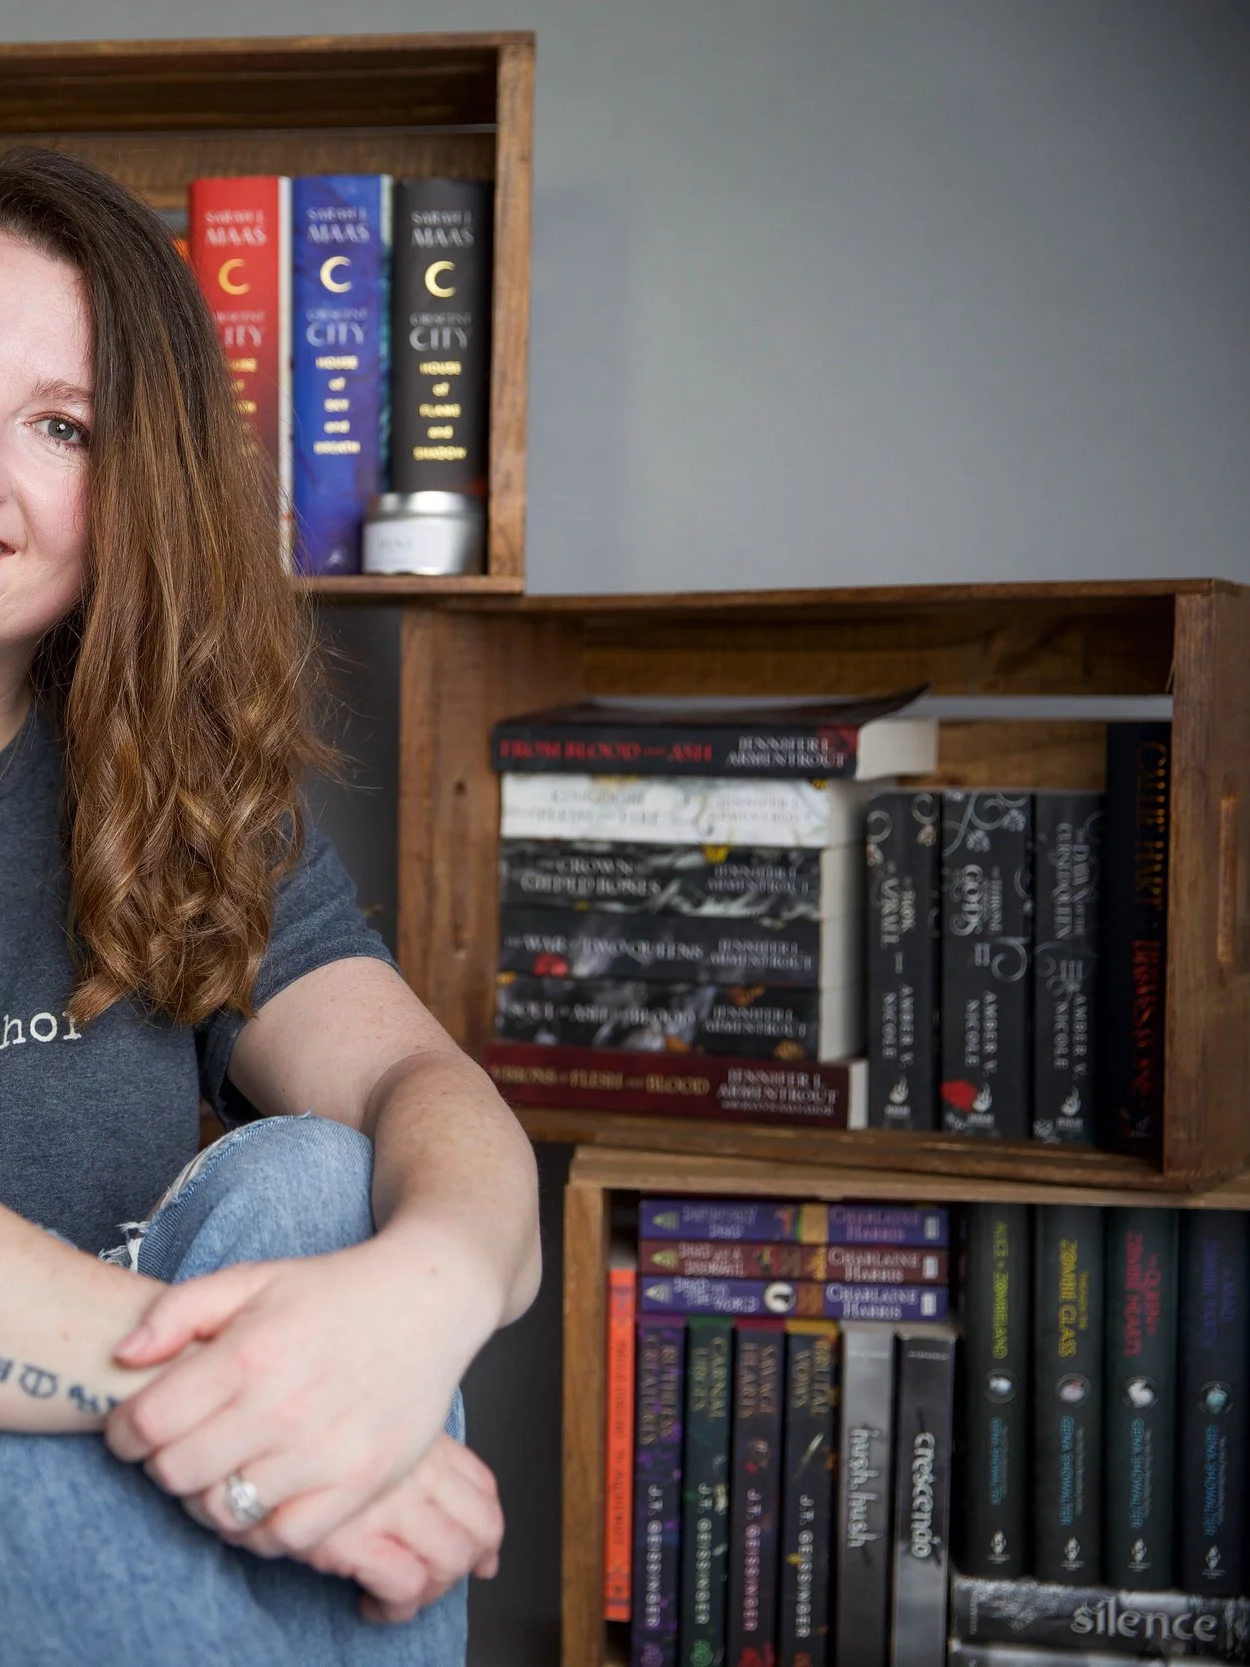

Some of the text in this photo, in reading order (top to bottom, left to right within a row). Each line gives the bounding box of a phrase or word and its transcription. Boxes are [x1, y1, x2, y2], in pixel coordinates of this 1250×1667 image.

[222, 323, 263, 348] ITY
[306, 322, 365, 348] CITY
[409, 325, 469, 351] CITY
[1058, 1304, 1078, 1358] GLASS
[847, 1491, 884, 1548] hush
[910, 1431, 942, 1559] crescendo
[645, 1519, 663, 1628] GEISSINGER
[694, 1517, 713, 1626] GEISSINGER
[742, 1523, 761, 1632] GEISSINGER
[794, 1530, 814, 1639] GEISSINGER
[1069, 1597, 1218, 1642] silence
